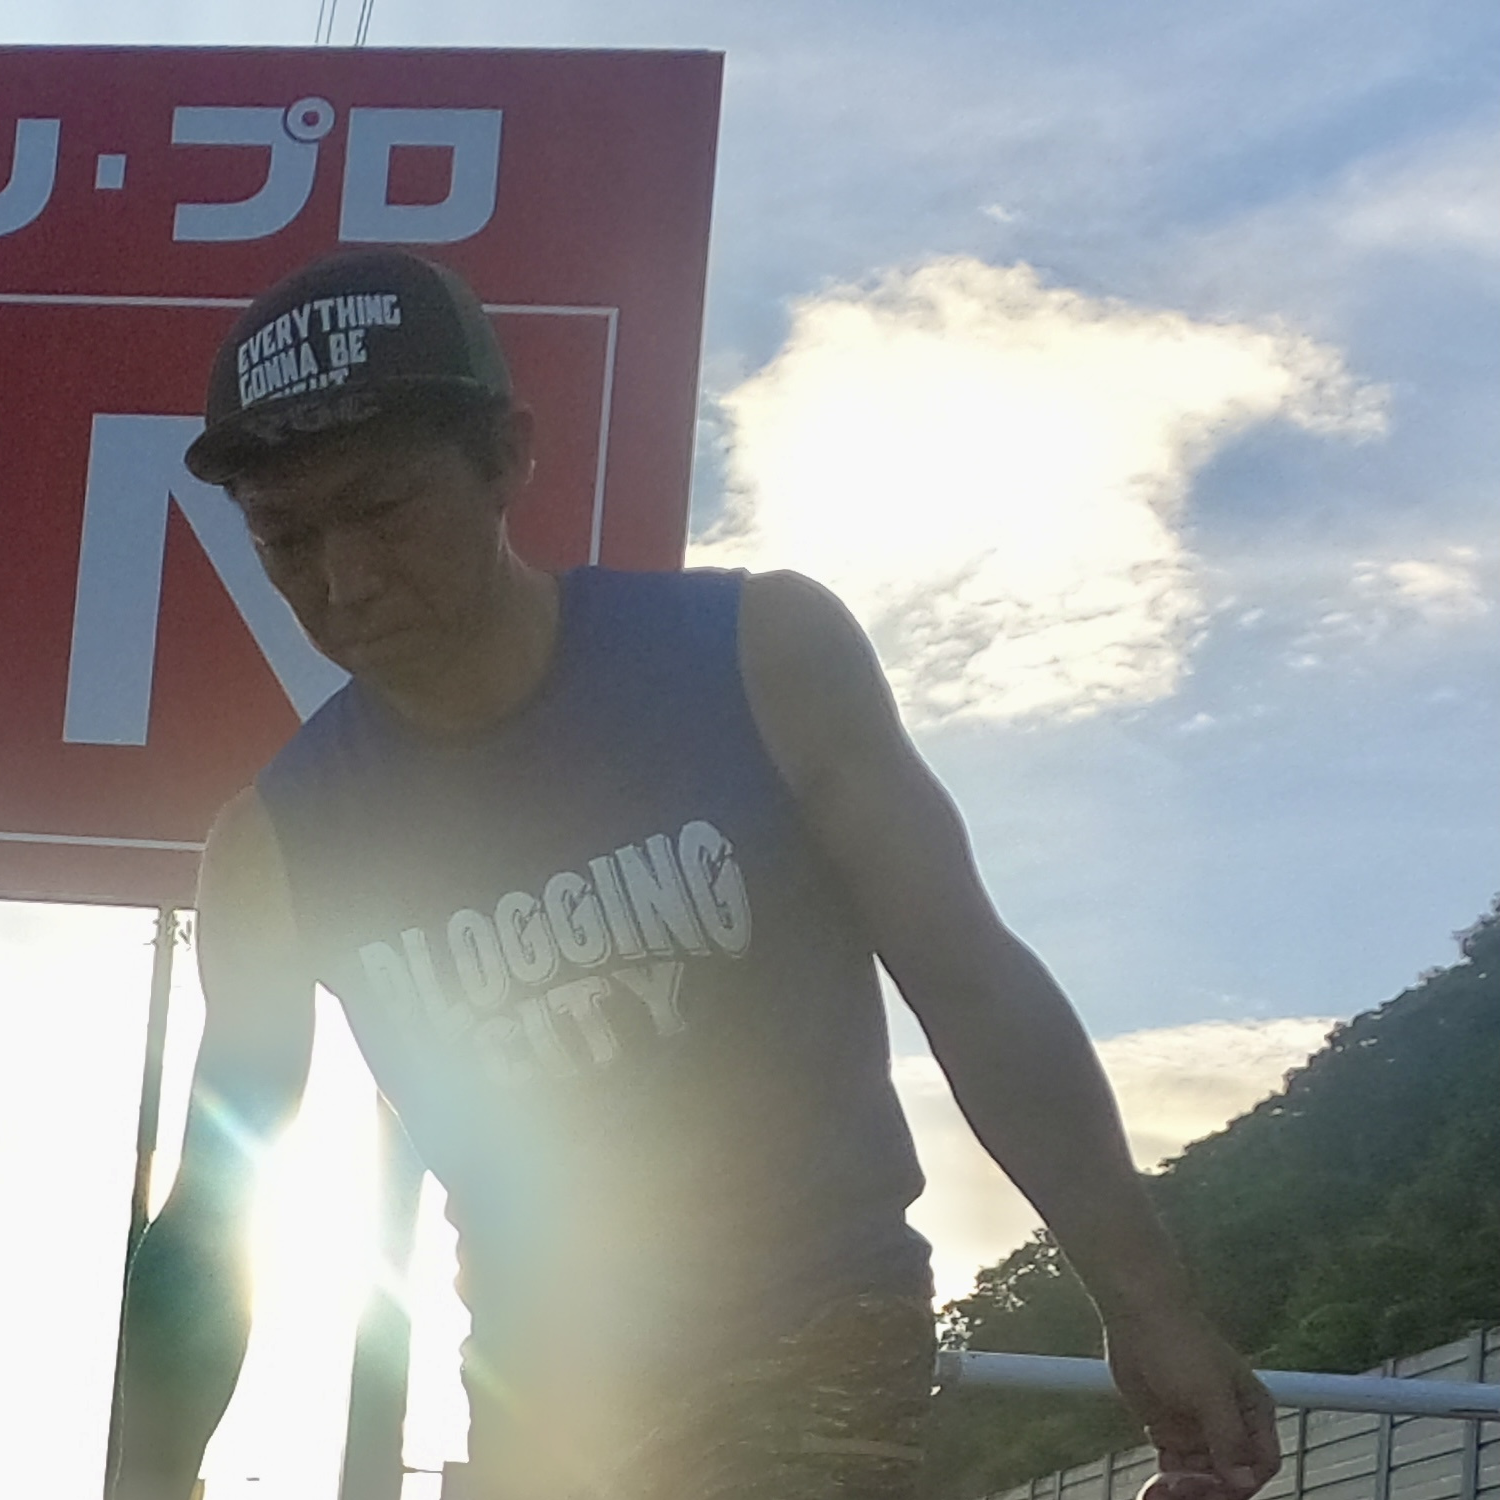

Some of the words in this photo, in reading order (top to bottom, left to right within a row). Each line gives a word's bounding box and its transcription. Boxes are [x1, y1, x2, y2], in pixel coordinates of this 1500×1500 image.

[236, 293, 402, 374] EVERYTHING
[240, 342, 318, 409] GONNA
[329, 328, 368, 366] BE
